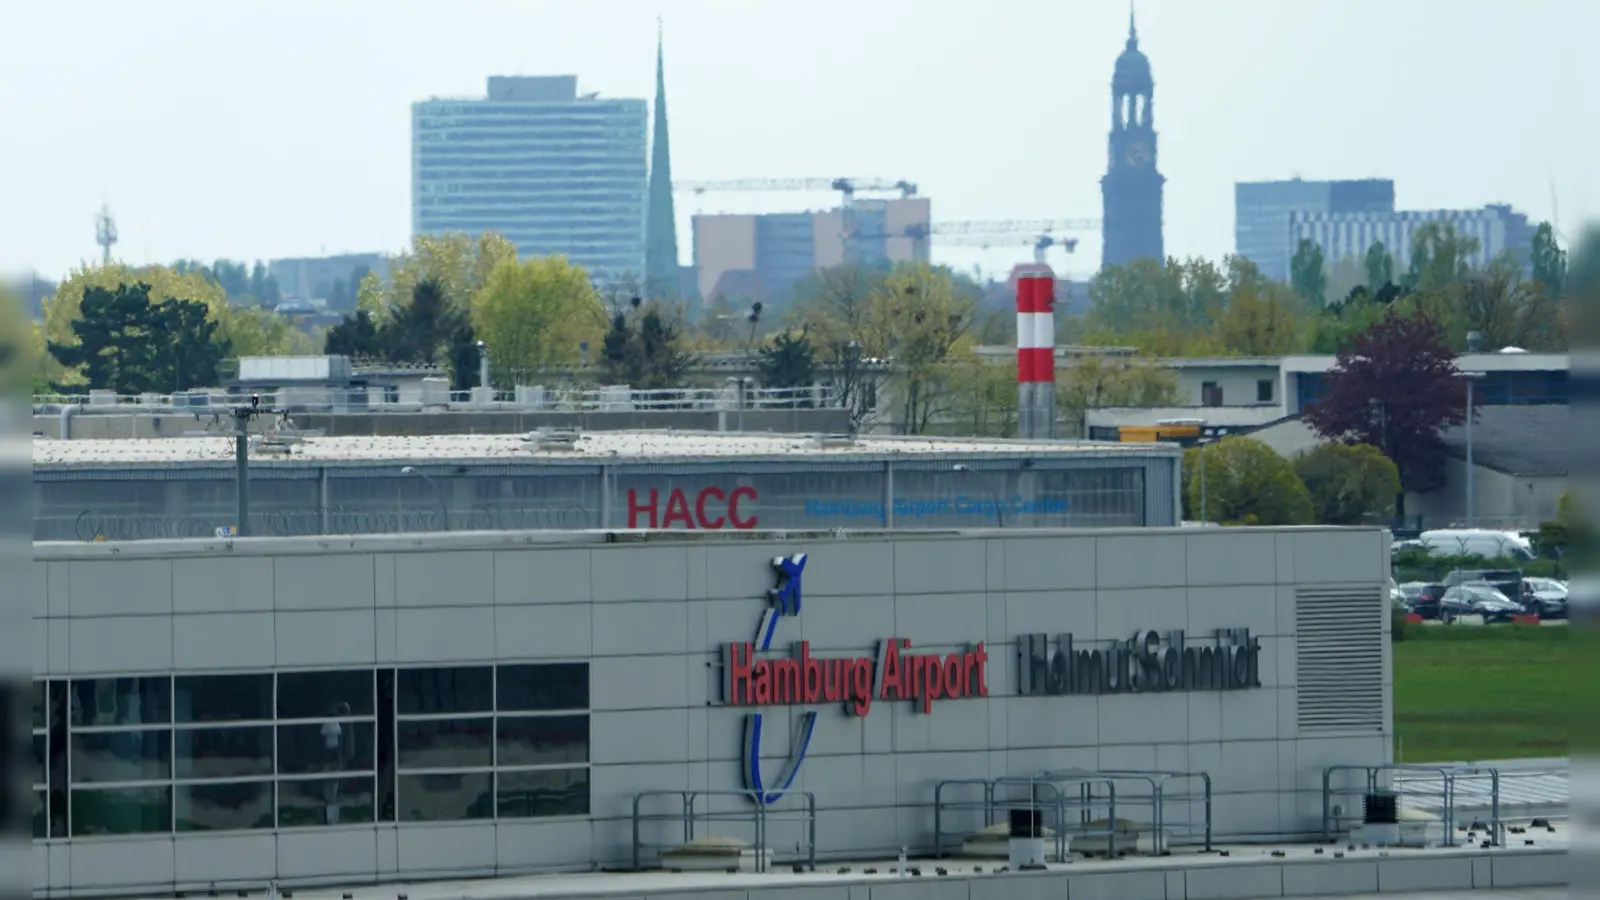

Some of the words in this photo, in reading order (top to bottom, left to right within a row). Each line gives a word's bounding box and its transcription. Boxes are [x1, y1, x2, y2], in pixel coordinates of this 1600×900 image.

[627, 486, 758, 529] HACC
[727, 641, 871, 716] Hamburg
[879, 637, 987, 715] Airport
[1018, 633, 1131, 695] Helmut
[1134, 628, 1261, 693] Schmidt
